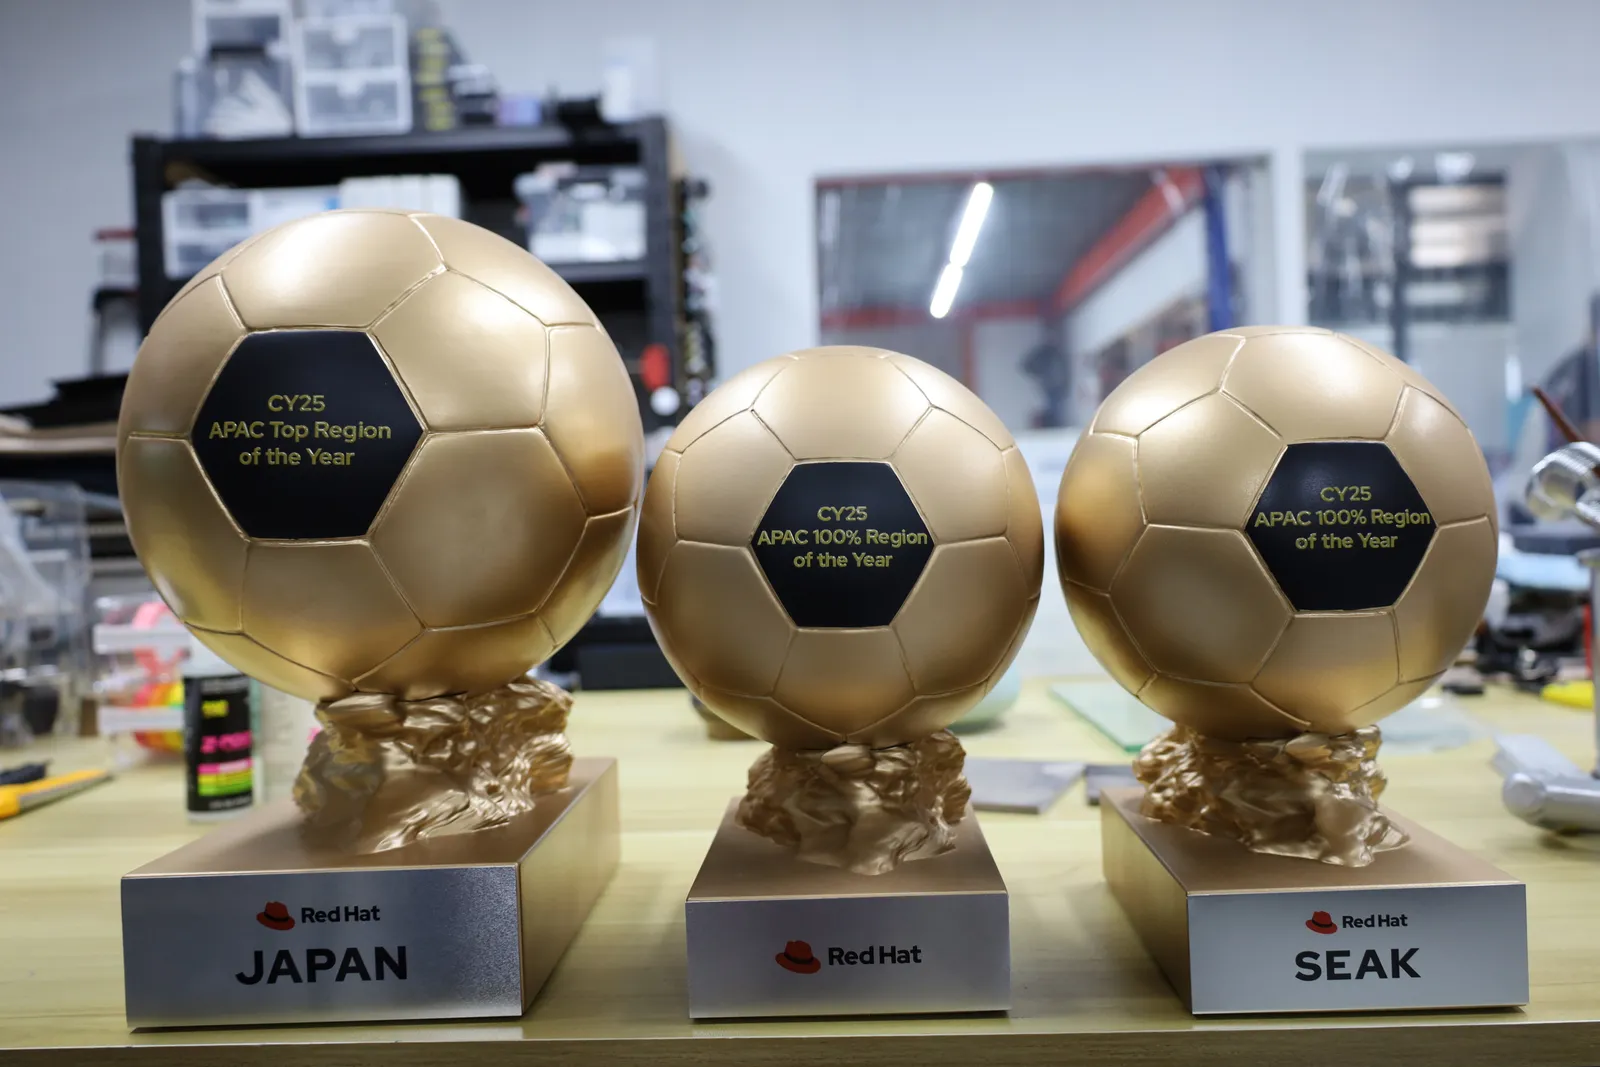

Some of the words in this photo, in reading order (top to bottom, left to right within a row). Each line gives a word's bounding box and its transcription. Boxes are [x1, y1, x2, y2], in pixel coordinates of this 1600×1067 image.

[267, 394, 326, 412] CY25
[208, 421, 265, 439] APAC
[269, 421, 309, 442] Top
[314, 421, 392, 443] Region
[238, 447, 261, 465] of
[266, 447, 301, 465] the
[306, 448, 355, 465] Year
[1319, 486, 1372, 502] CY25
[816, 506, 868, 522] CY25
[1253, 511, 1311, 528] APAC
[1315, 509, 1367, 525] 100%
[1370, 509, 1431, 528] Region
[757, 530, 809, 545] APAC
[812, 529, 862, 545] 100%
[866, 529, 928, 548] Region
[1295, 533, 1317, 550] of
[1321, 533, 1354, 549] the
[1357, 533, 1398, 548] Year
[793, 552, 813, 568] of
[816, 553, 848, 568] the
[852, 552, 893, 567] Year
[301, 906, 341, 923] Red
[344, 905, 381, 922] Hat
[1342, 914, 1375, 928] Red
[1378, 914, 1408, 928] Hat
[828, 946, 875, 966] Red
[879, 945, 922, 964] Hat
[235, 946, 408, 985] JAPAN
[1294, 948, 1421, 982] SEAK
